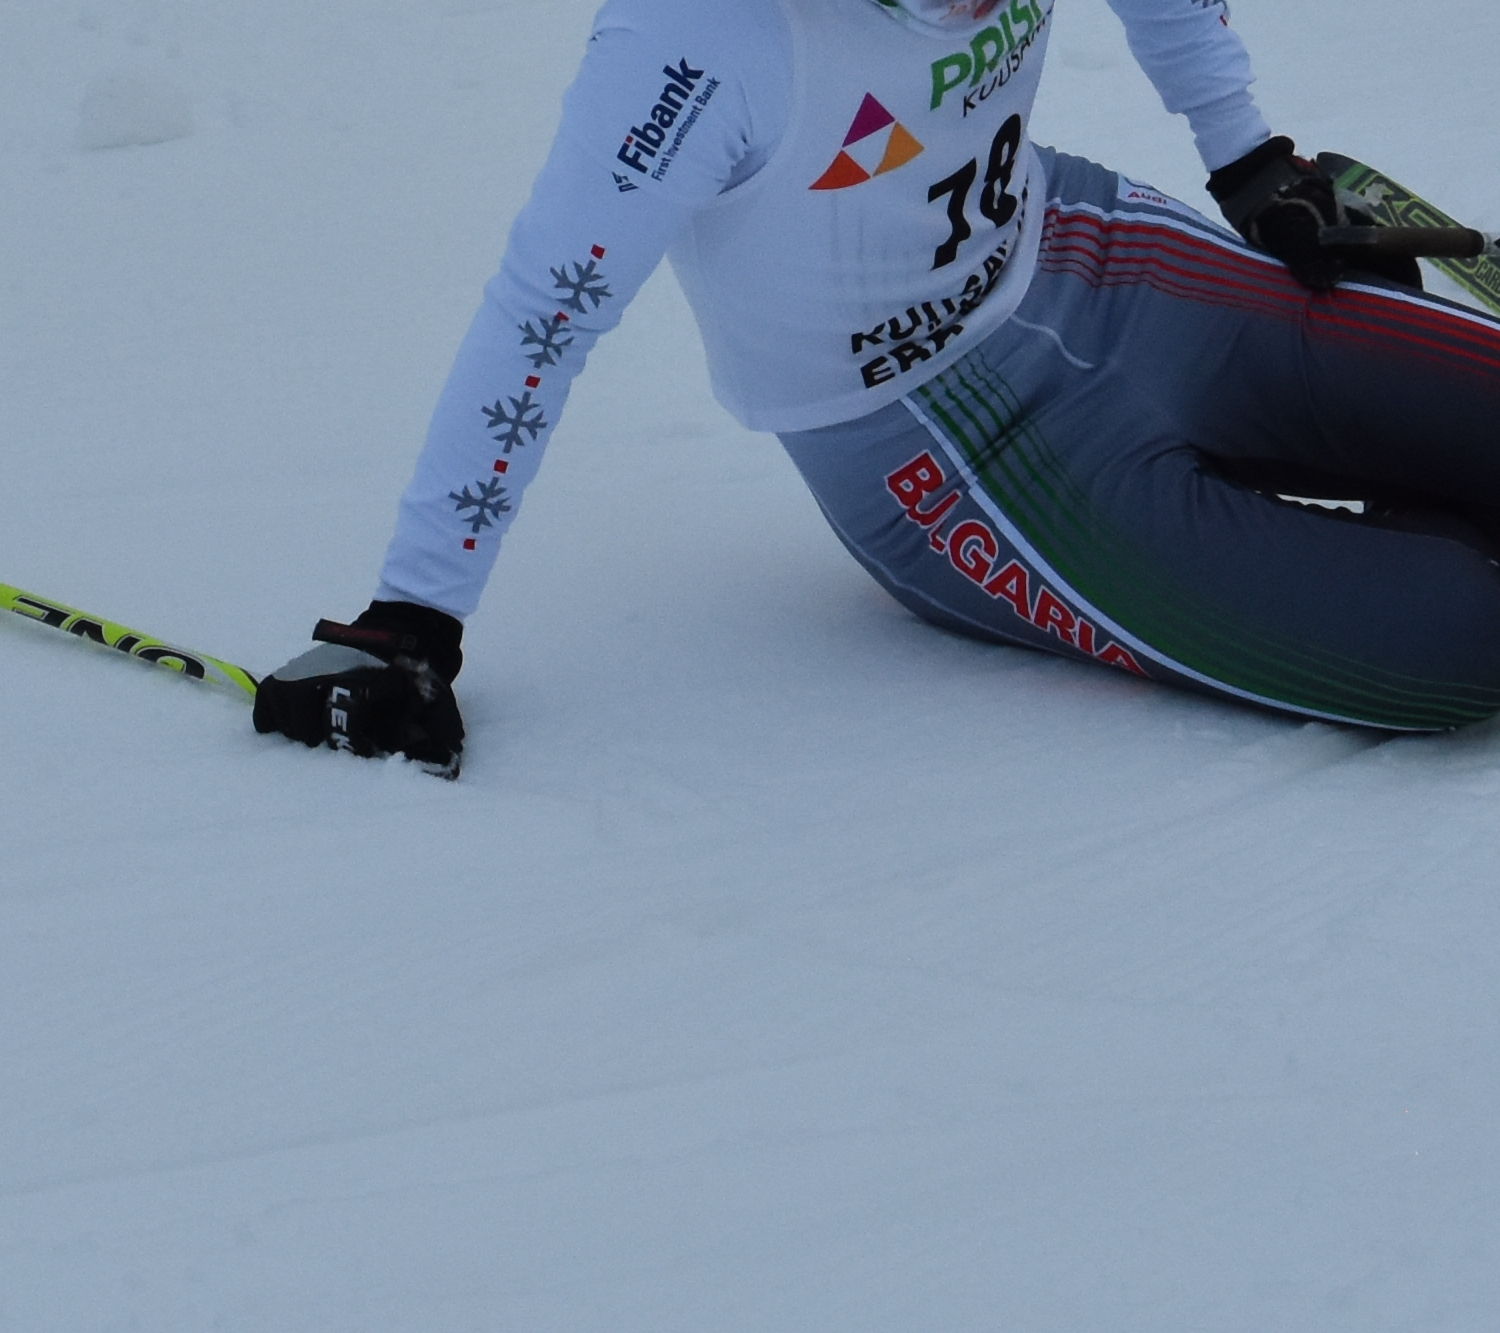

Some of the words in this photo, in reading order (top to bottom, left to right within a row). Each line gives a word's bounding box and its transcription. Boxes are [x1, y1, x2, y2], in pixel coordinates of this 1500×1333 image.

[616, 56, 705, 174] Fibank
[651, 157, 672, 182] First
[662, 104, 703, 159] Investment
[694, 76, 721, 106] Bank
[927, 113, 1022, 271] 78
[1127, 191, 1167, 205] Audi
